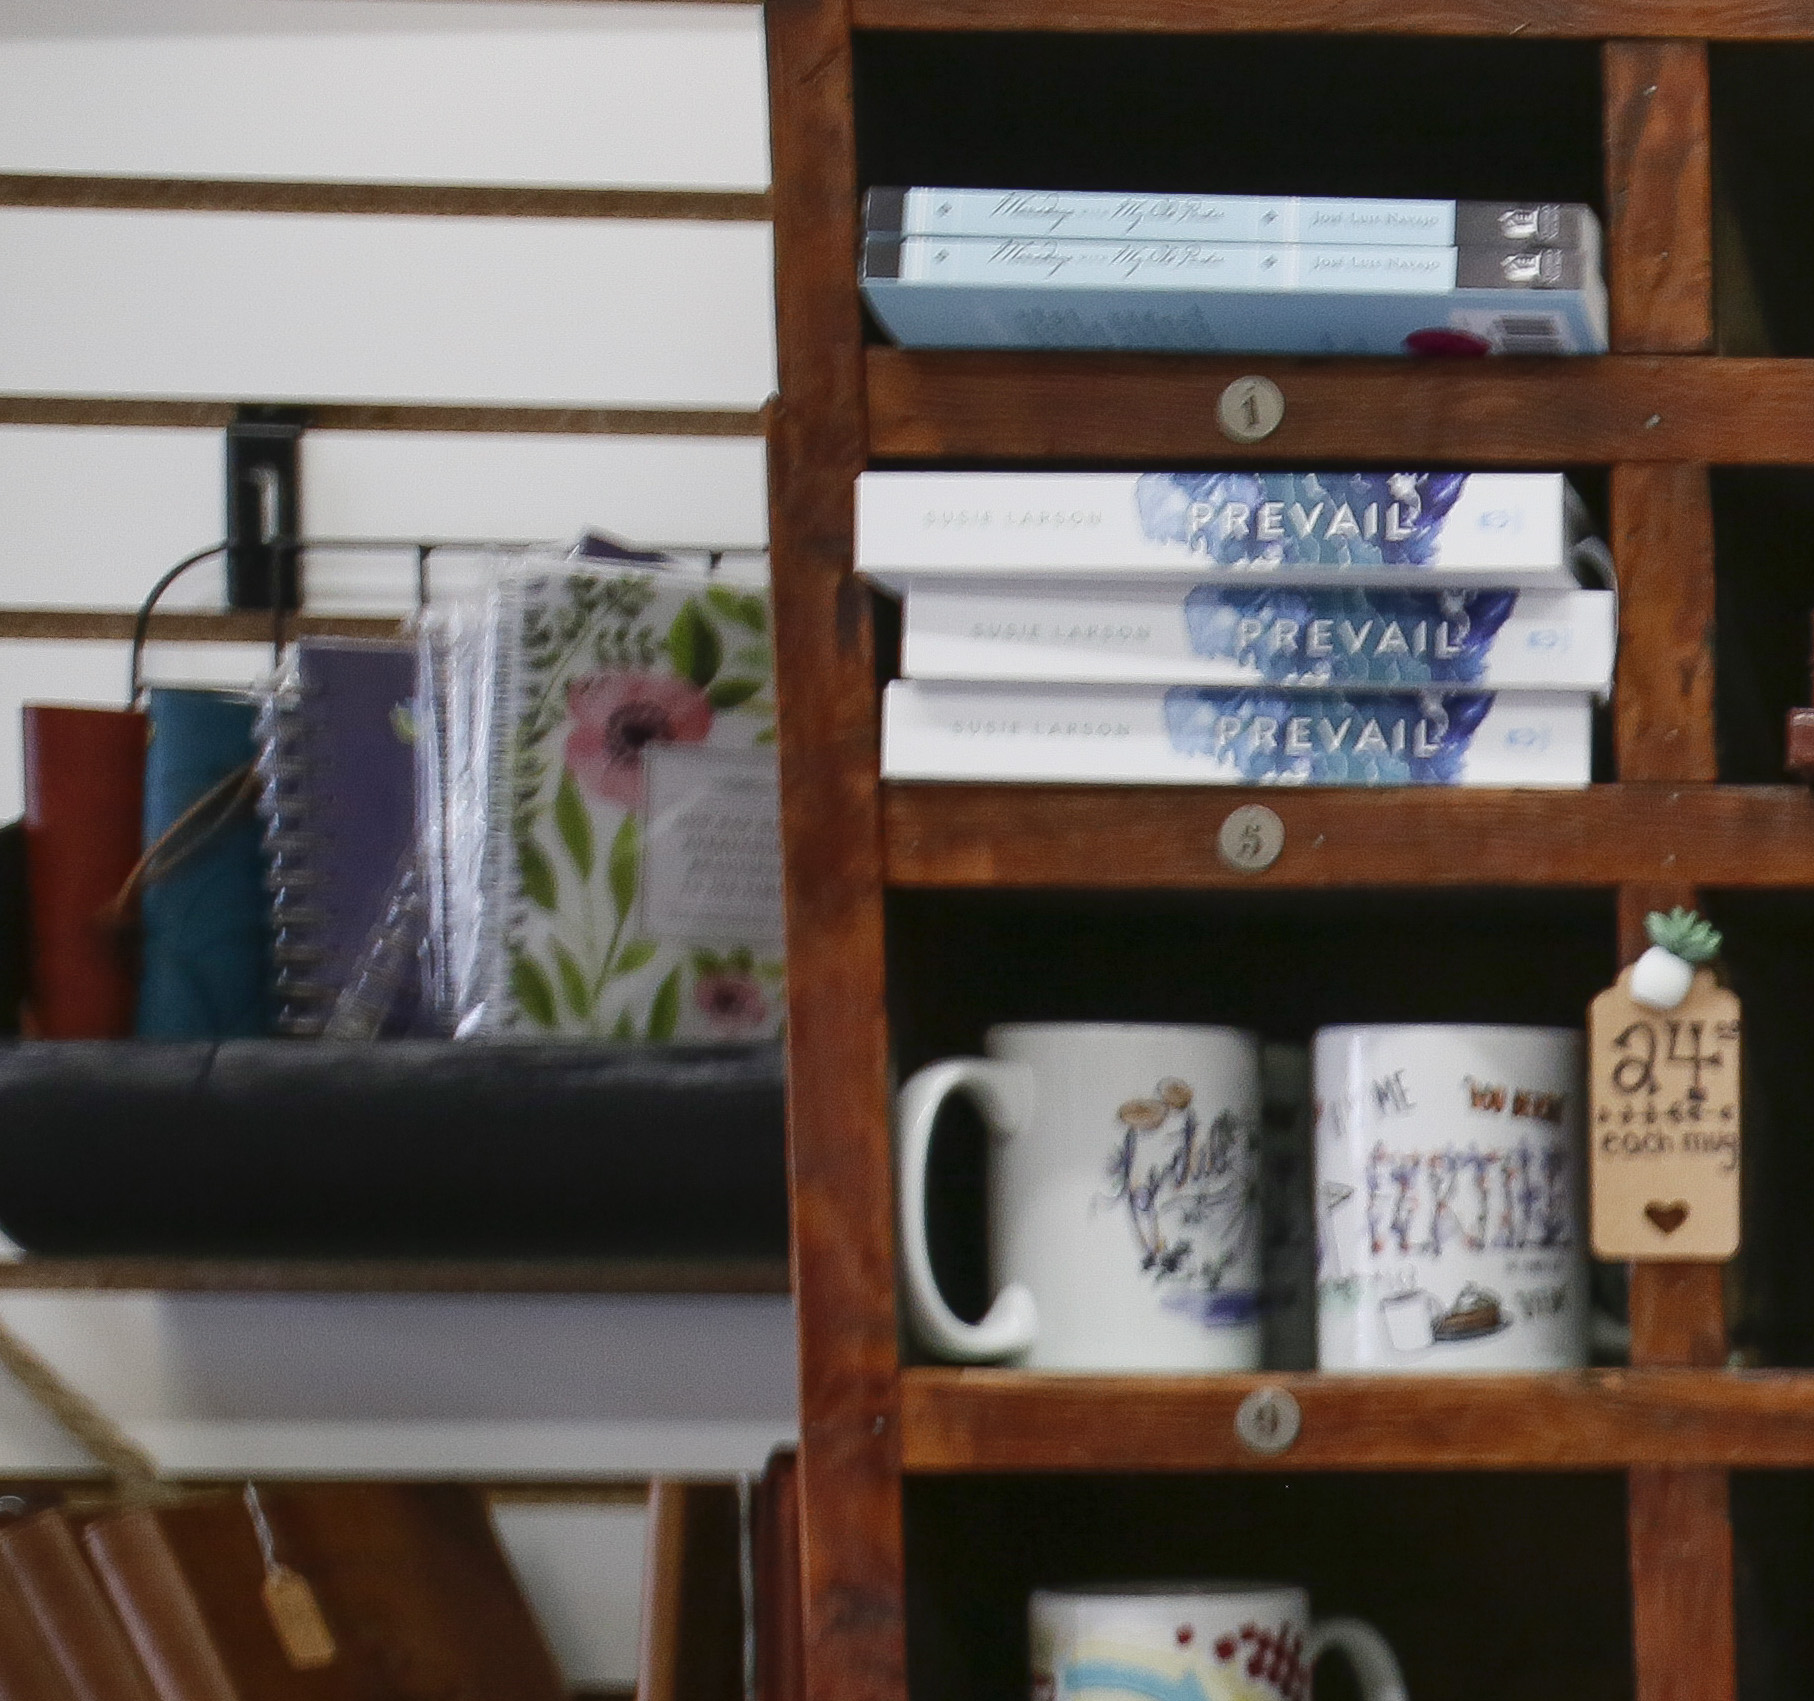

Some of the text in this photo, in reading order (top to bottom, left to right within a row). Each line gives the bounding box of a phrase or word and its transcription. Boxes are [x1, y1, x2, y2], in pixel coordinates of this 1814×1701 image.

[924, 509, 1102, 528] SUSIE LARSON
[1187, 500, 1415, 540] PREVAIL
[1053, 623, 1151, 643] LARSON
[1237, 617, 1466, 659] PREVAIL
[1033, 719, 1131, 738] LARSON
[1216, 714, 1444, 760] PREVAIL
